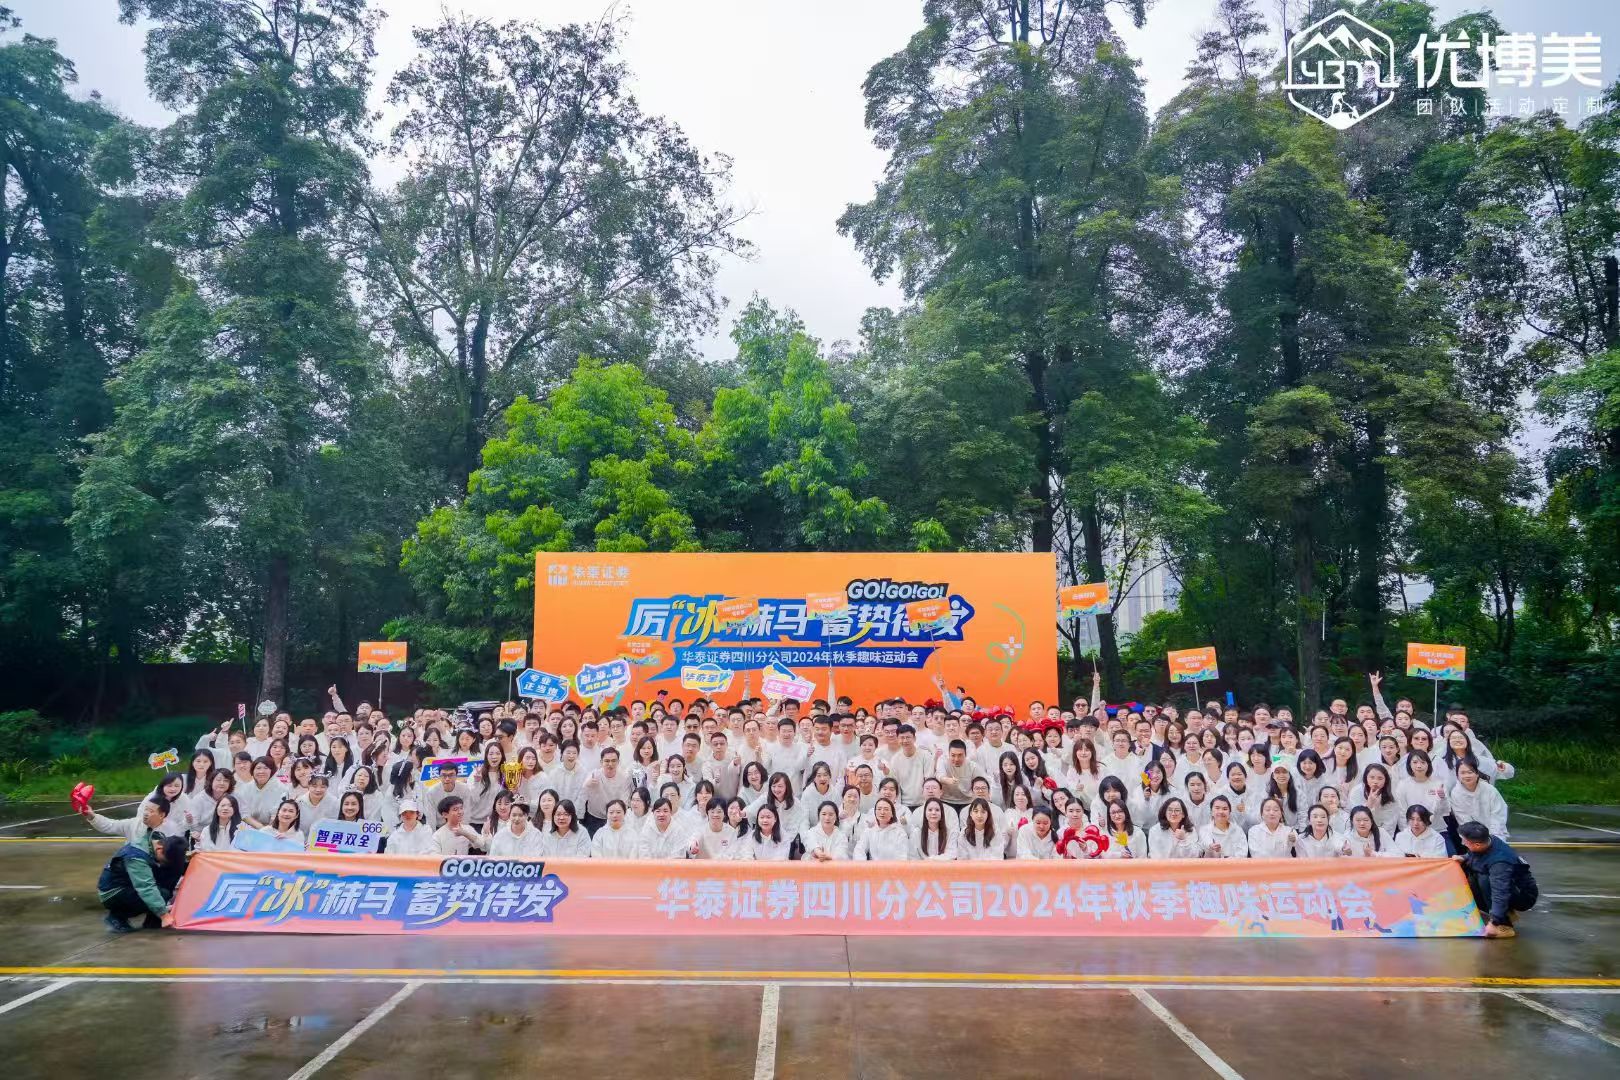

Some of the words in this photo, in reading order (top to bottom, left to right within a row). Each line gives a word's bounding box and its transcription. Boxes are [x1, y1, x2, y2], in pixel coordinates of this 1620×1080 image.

[847, 581, 945, 600] GO!GO!GO!
[682, 651, 919, 664] 华泰证券四川分公司2024年秋季趣味运动会
[362, 822, 382, 833] 666
[316, 829, 370, 848] 智勇双全
[442, 859, 541, 877] GO!GO!GO!
[404, 879, 563, 925] 蓄势待发
